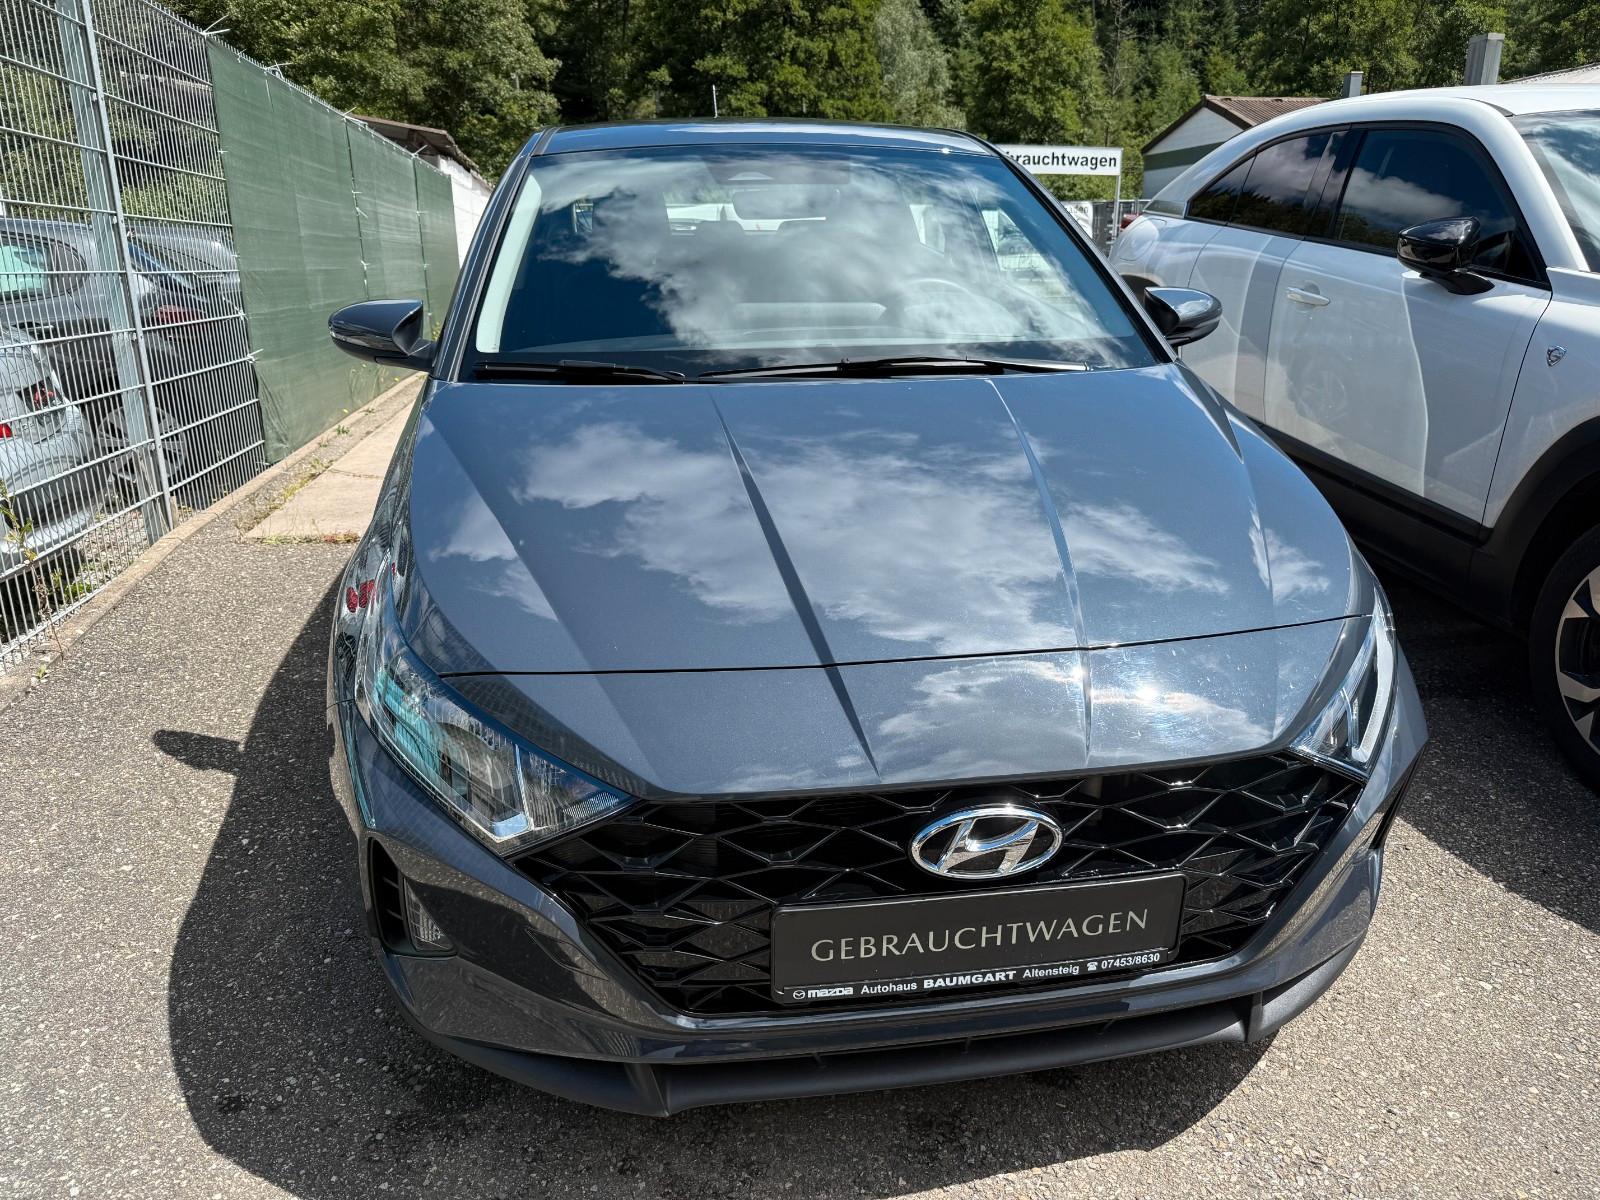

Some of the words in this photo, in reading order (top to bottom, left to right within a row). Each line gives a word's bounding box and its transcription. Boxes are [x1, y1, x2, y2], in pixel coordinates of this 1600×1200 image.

[810, 908, 1148, 962] GEBRAUCHTWAGEN
[807, 986, 854, 998] mazda
[860, 981, 918, 995] Autohaus
[923, 970, 1017, 989] BAUMGART
[1022, 964, 1080, 979] Altensteig
[1101, 953, 1161, 970] 07453/8630
